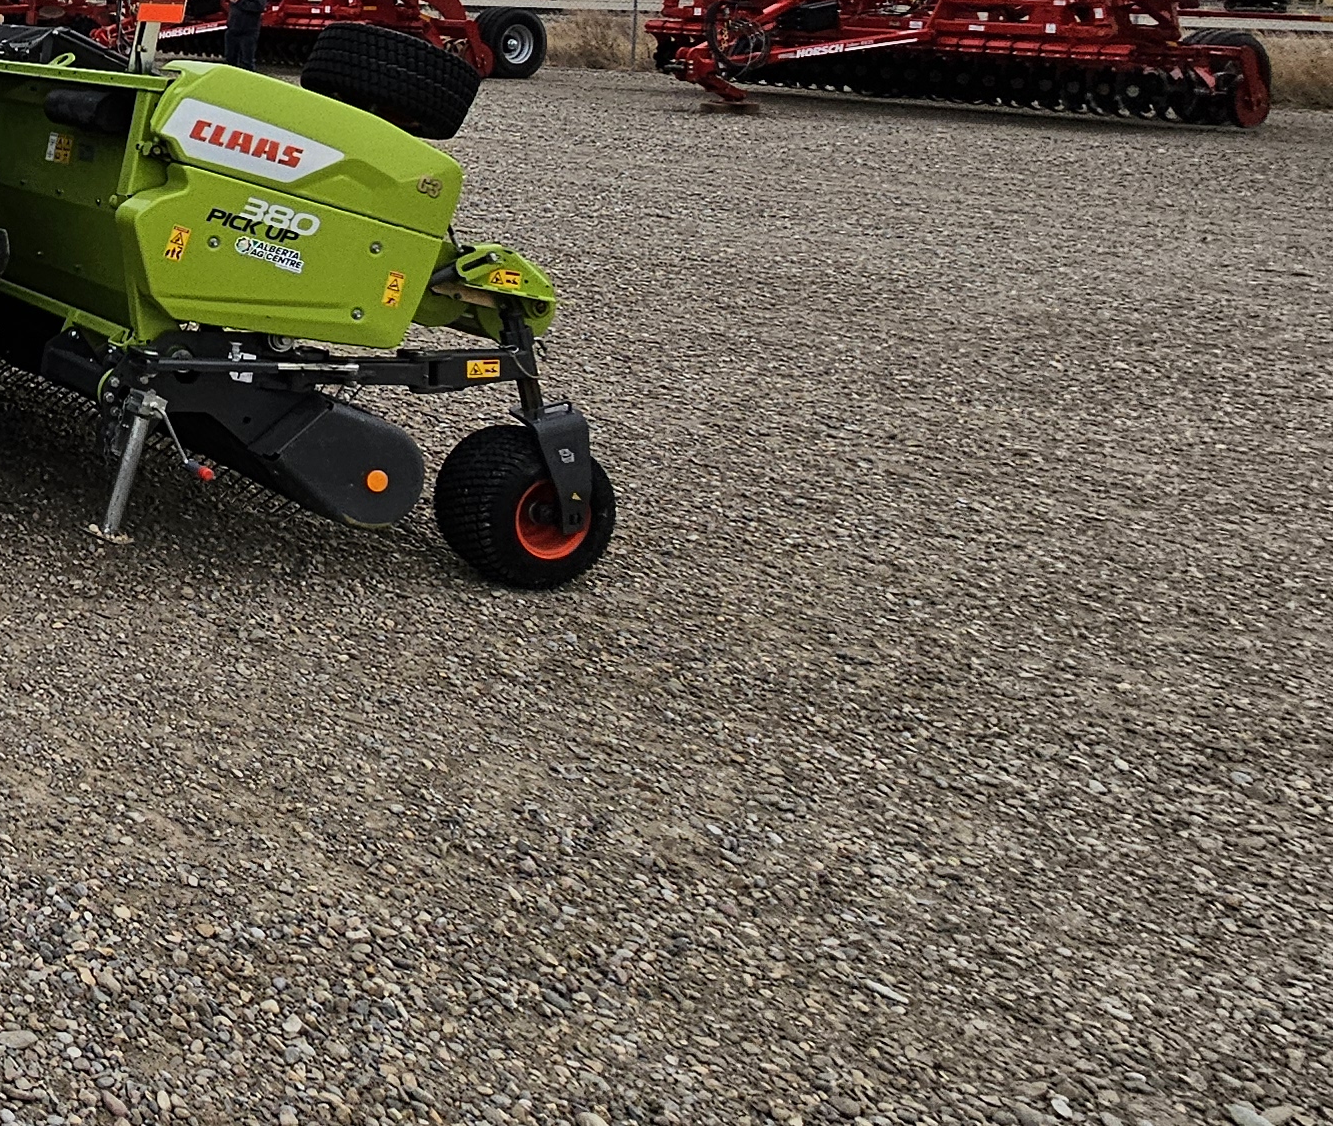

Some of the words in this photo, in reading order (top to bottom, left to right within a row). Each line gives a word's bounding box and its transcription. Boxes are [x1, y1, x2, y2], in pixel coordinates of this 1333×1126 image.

[796, 44, 844, 58] HORSCH
[189, 119, 304, 168] CLAAS
[205, 207, 263, 236] PICK
[264, 224, 300, 244] UP
[237, 196, 321, 236] 380
[250, 249, 264, 258] AG
[266, 253, 303, 269] CENTRE
[257, 242, 299, 260] ALBERTA
